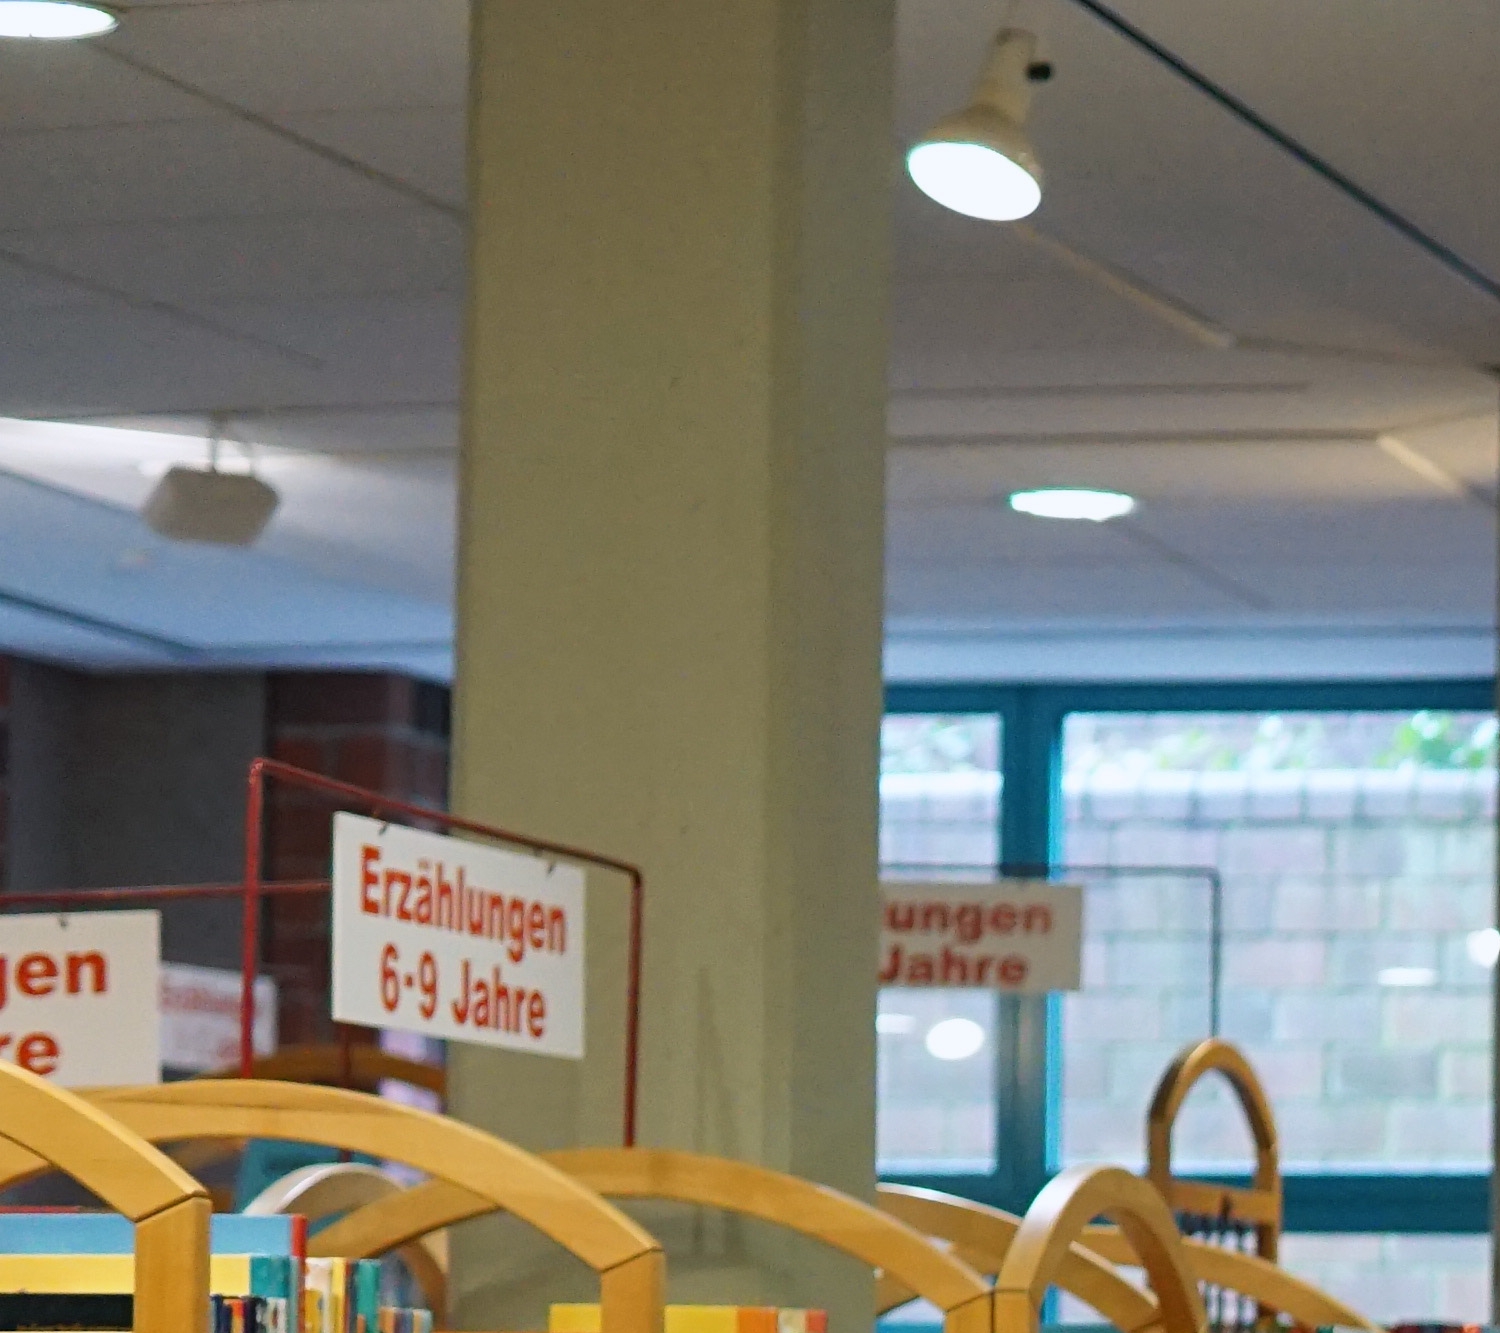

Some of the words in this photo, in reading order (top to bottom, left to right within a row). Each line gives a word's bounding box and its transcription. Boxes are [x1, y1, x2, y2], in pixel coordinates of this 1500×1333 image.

[359, 844, 567, 964] Erzählungen
[378, 943, 439, 1020] 6-9
[452, 959, 546, 1039] Jahre
